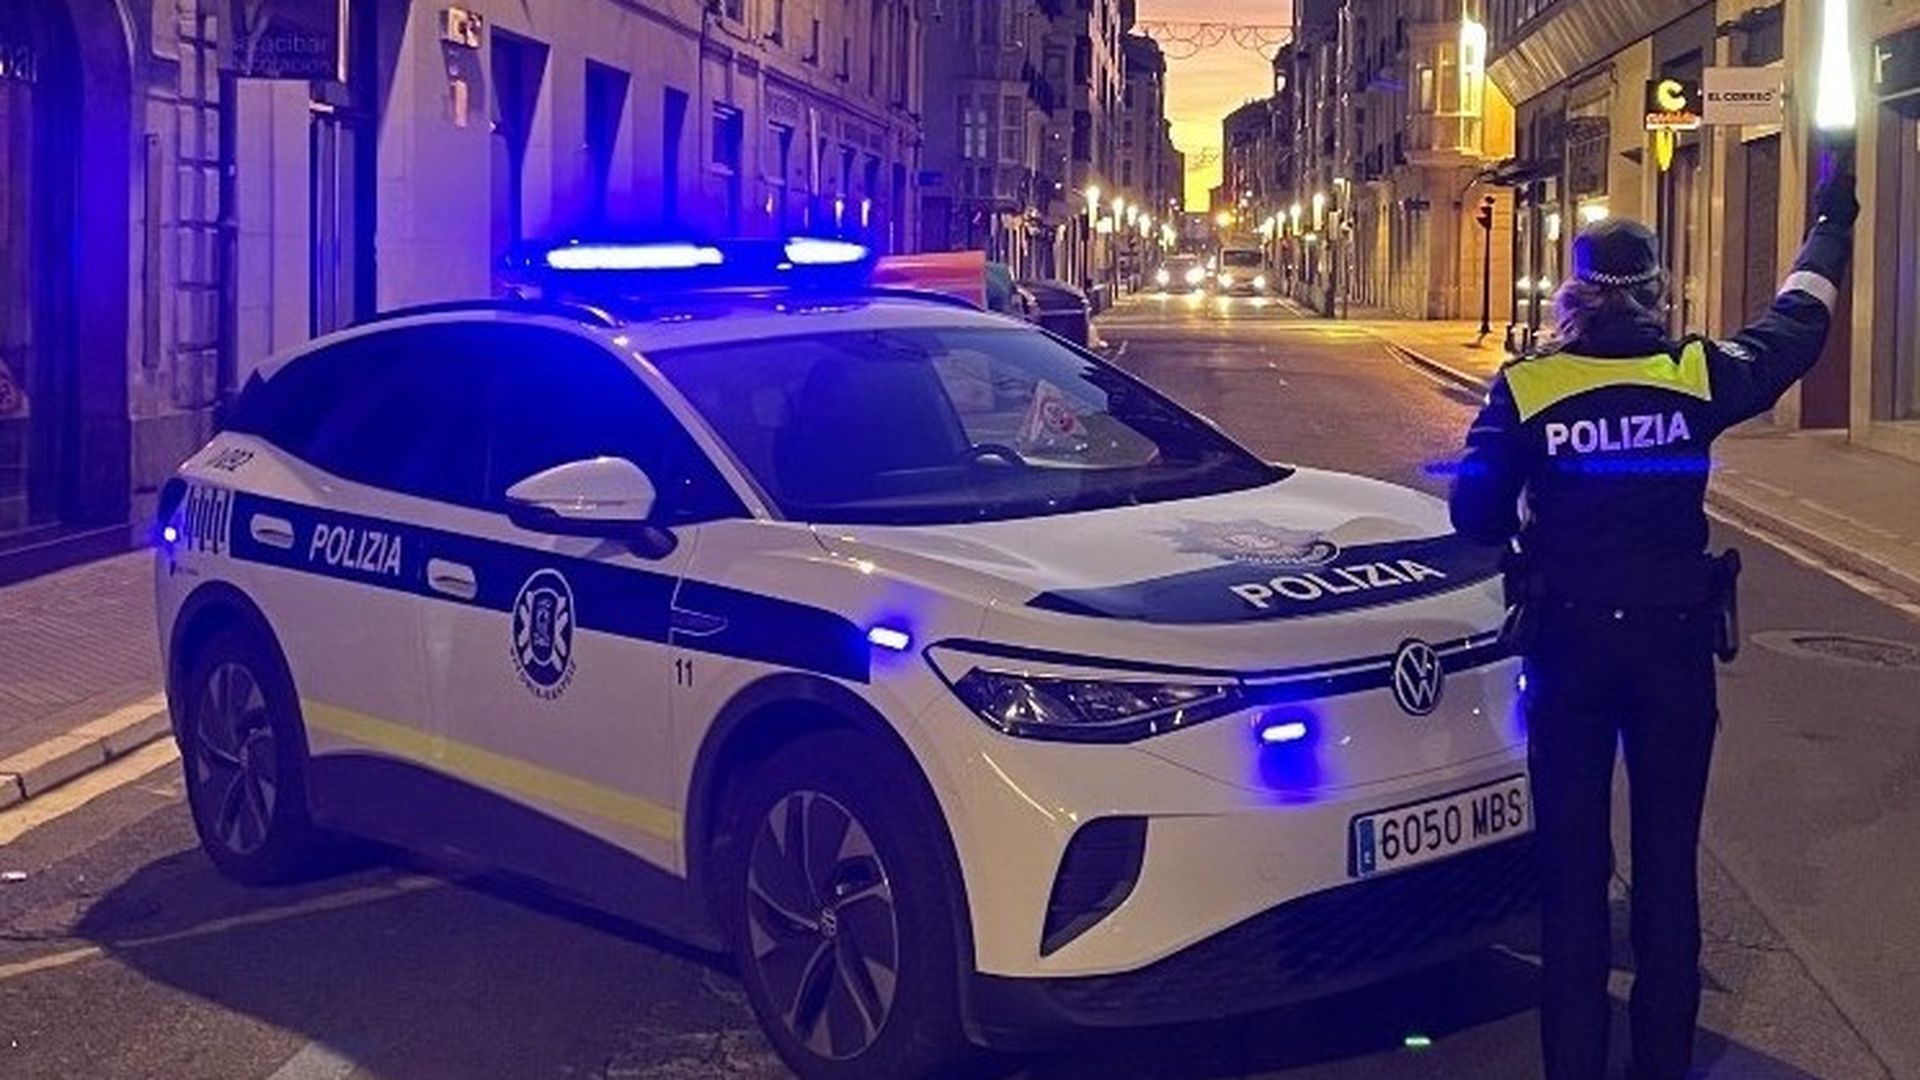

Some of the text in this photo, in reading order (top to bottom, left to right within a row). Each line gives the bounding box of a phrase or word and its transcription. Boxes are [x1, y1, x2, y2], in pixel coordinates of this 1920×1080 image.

[1708, 92, 1773, 101] EL CORREO
[1545, 410, 1692, 456] POLIZIA
[308, 523, 402, 577] POLIZIA
[1229, 559, 1447, 609] POLIZIA
[674, 658, 694, 688] 11
[1382, 788, 1523, 860] 6050 MBS
